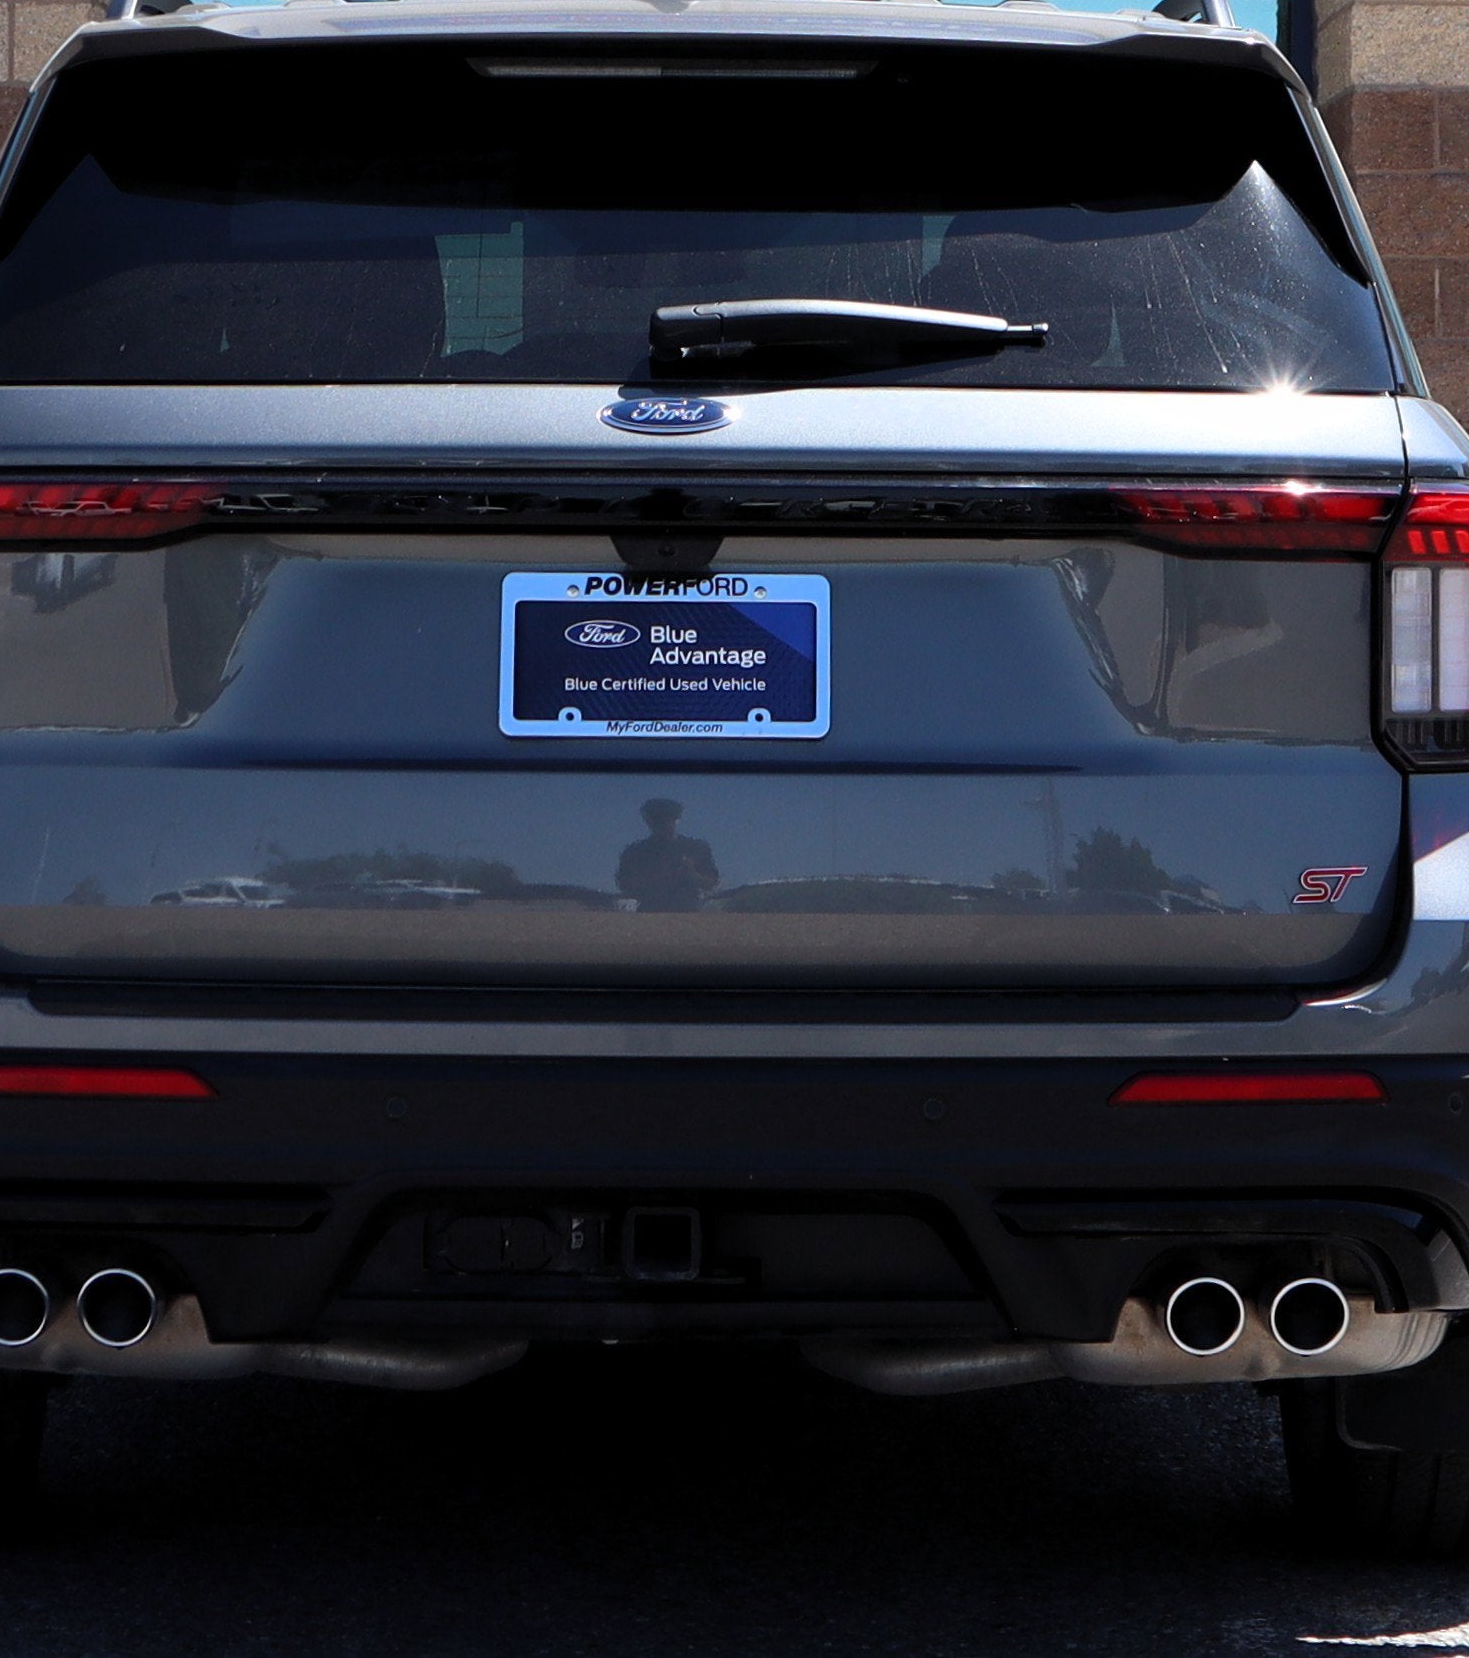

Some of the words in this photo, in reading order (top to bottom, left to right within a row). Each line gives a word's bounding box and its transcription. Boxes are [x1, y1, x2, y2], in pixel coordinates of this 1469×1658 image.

[630, 400, 705, 422] Ford
[579, 623, 628, 644] Ford
[649, 625, 698, 644] Blue
[649, 646, 767, 669] Advantage
[564, 677, 598, 691] Blue
[601, 677, 666, 691] Certified
[669, 677, 708, 691] Used
[711, 677, 766, 691] Vehicle
[605, 721, 723, 735] MyFordDealer.com
[1292, 866, 1369, 904] ST
